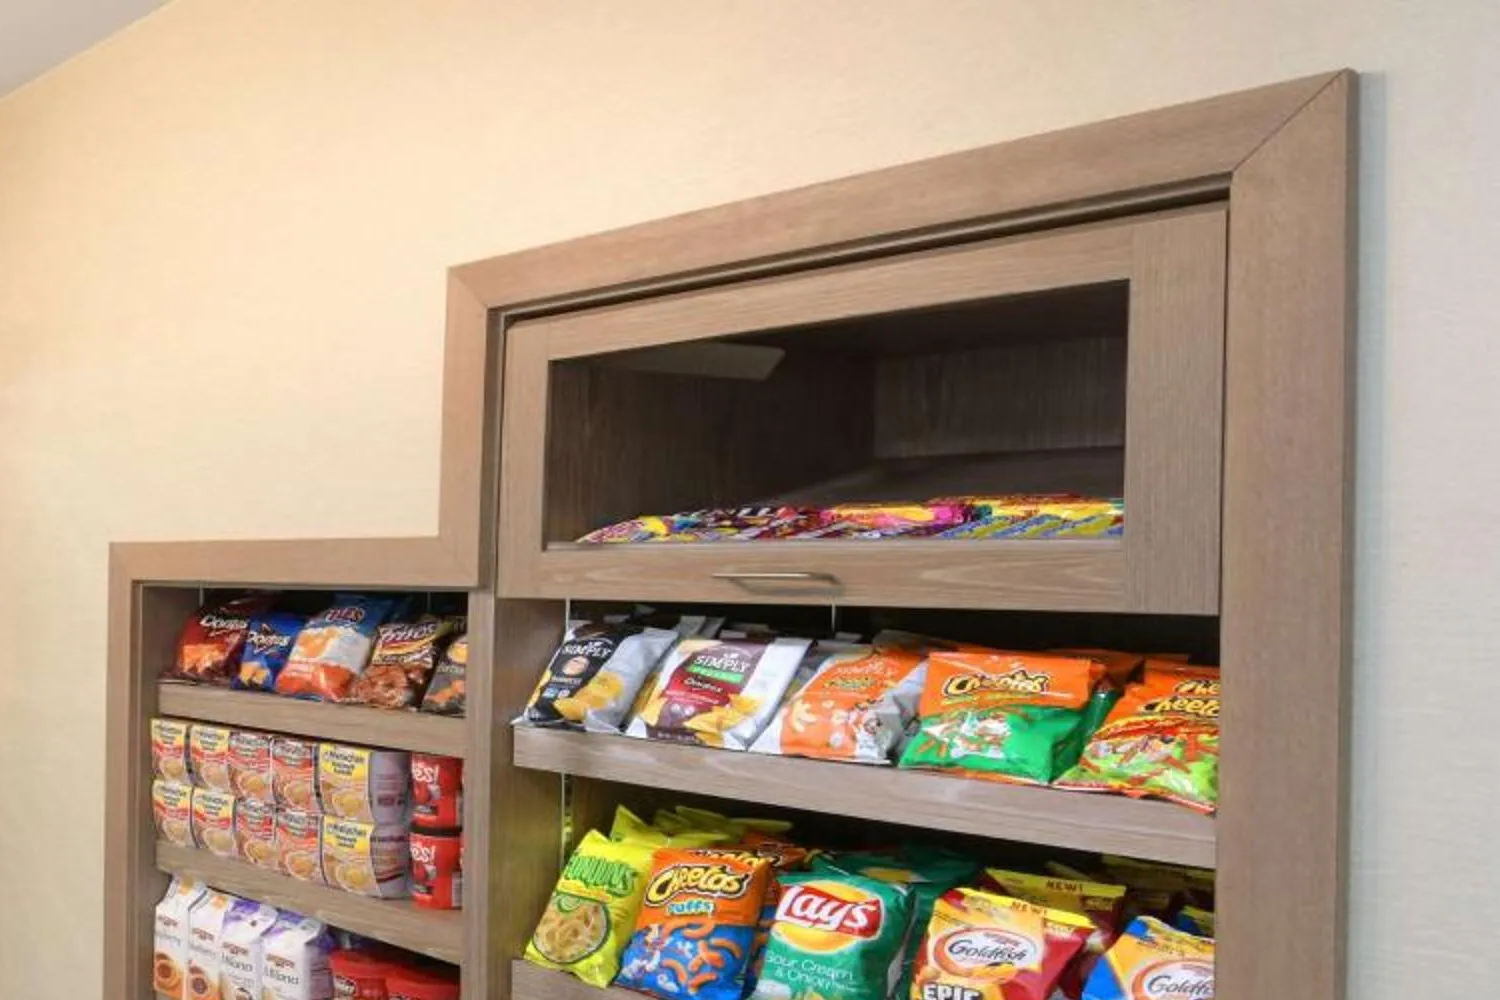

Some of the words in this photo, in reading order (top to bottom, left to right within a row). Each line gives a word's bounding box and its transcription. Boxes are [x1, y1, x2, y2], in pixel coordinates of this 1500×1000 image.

[694, 655, 751, 673] SIMPLY
[646, 864, 746, 905] Cheetos
[775, 885, 877, 931] Lay's
[948, 939, 1026, 961] Goldfish
